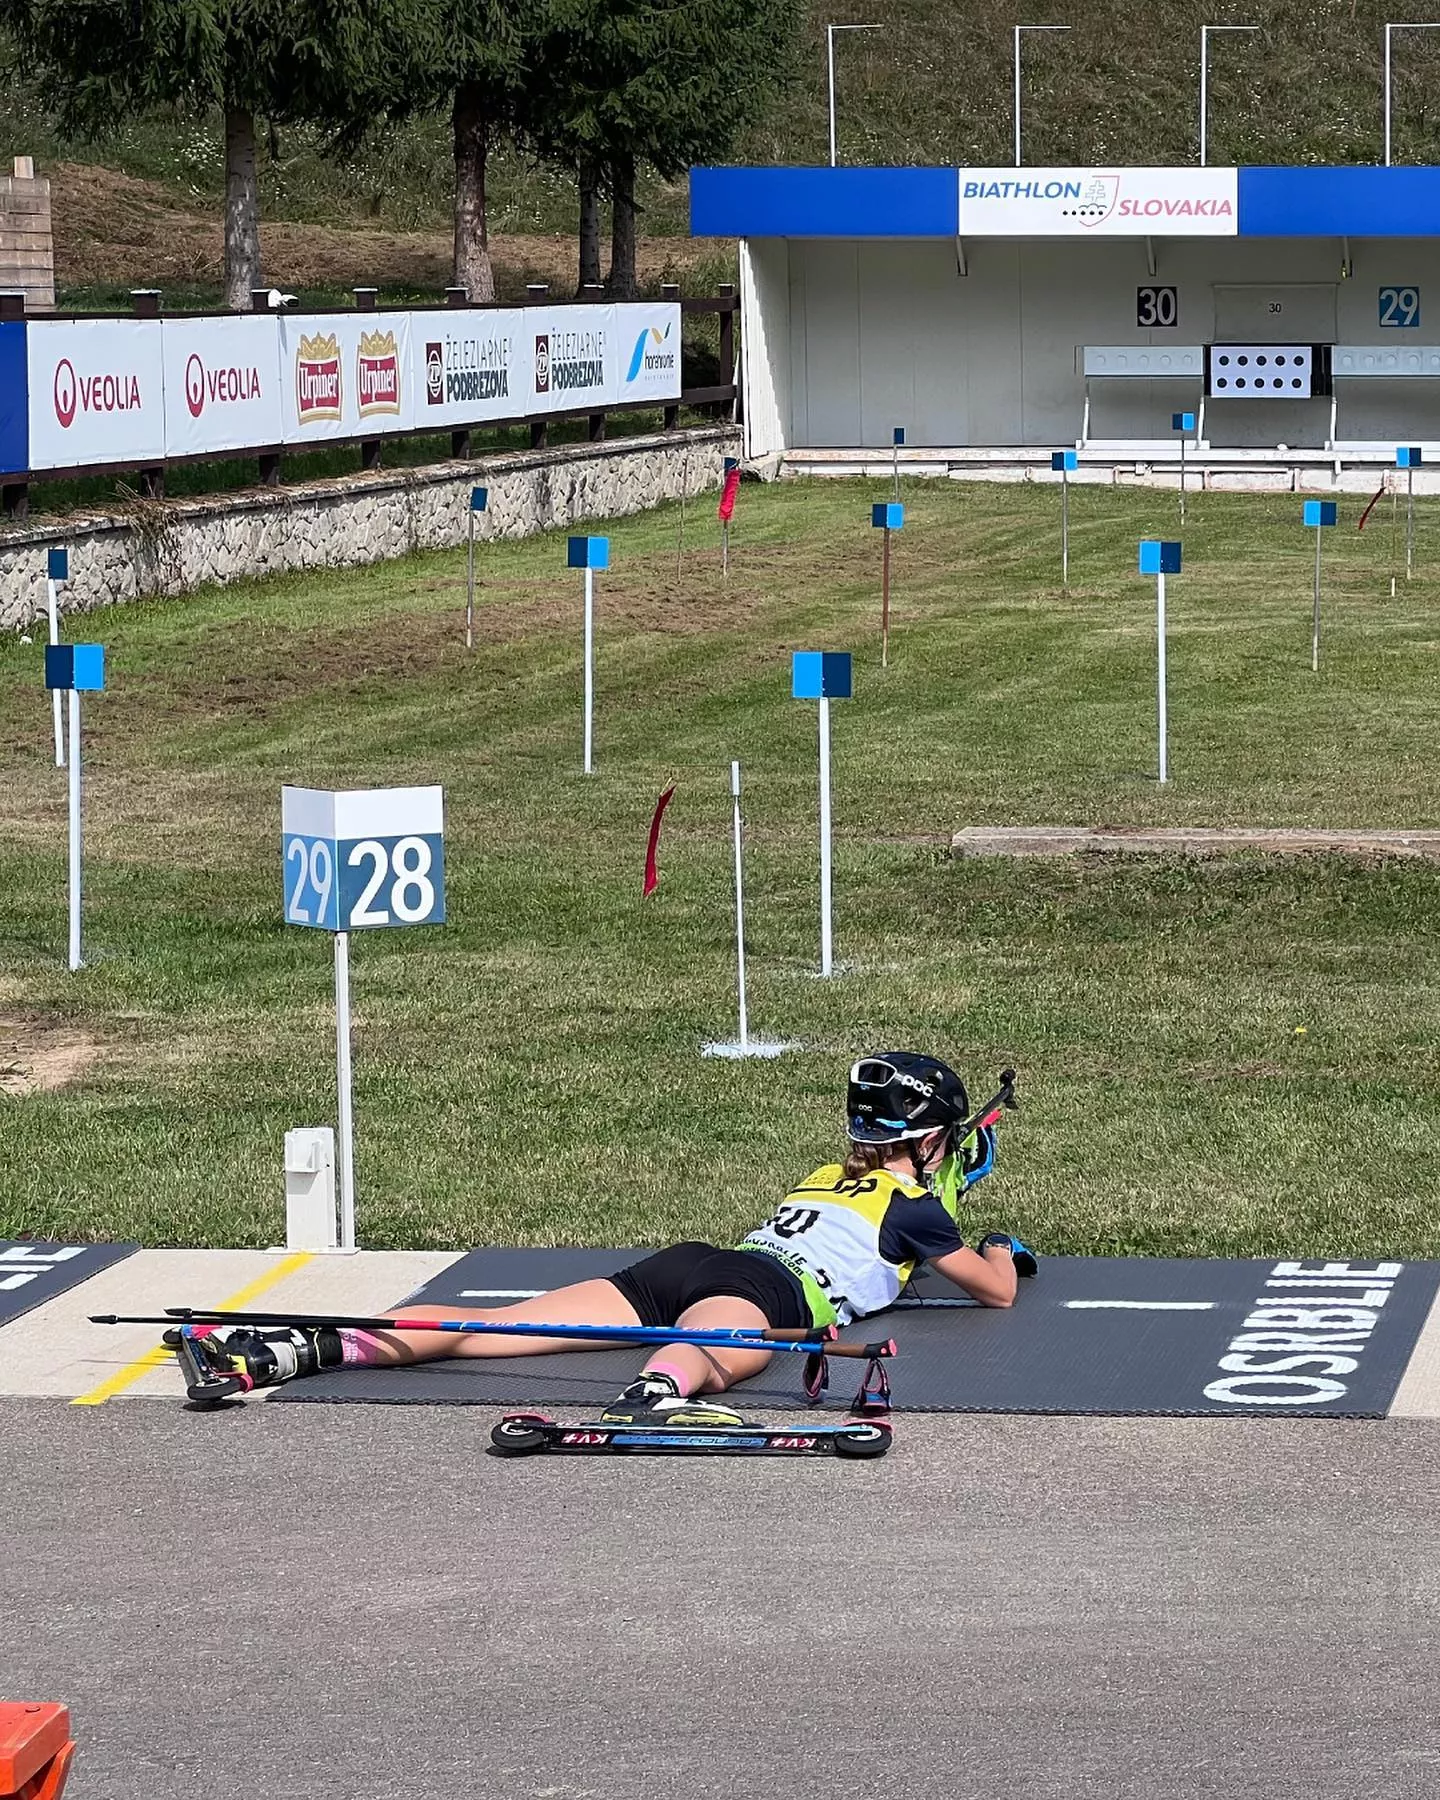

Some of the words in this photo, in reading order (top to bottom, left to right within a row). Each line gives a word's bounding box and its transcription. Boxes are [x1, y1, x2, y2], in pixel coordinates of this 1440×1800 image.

[963, 181, 1082, 199] BIATHLON
[1118, 199, 1233, 216] SLOVAKIA
[1138, 288, 1177, 326] 30
[1268, 303, 1282, 313] 30
[1380, 288, 1419, 326] 29
[446, 333, 508, 371] ŽELEZIARNE
[79, 374, 141, 412] VEOLIA
[207, 367, 262, 402] VEOLIA
[300, 365, 338, 407] Urpiner
[359, 361, 396, 402] Urpiner
[287, 838, 333, 924] 29
[347, 837, 435, 926] 28
[1203, 1262, 1405, 1405] OSRBLIE
